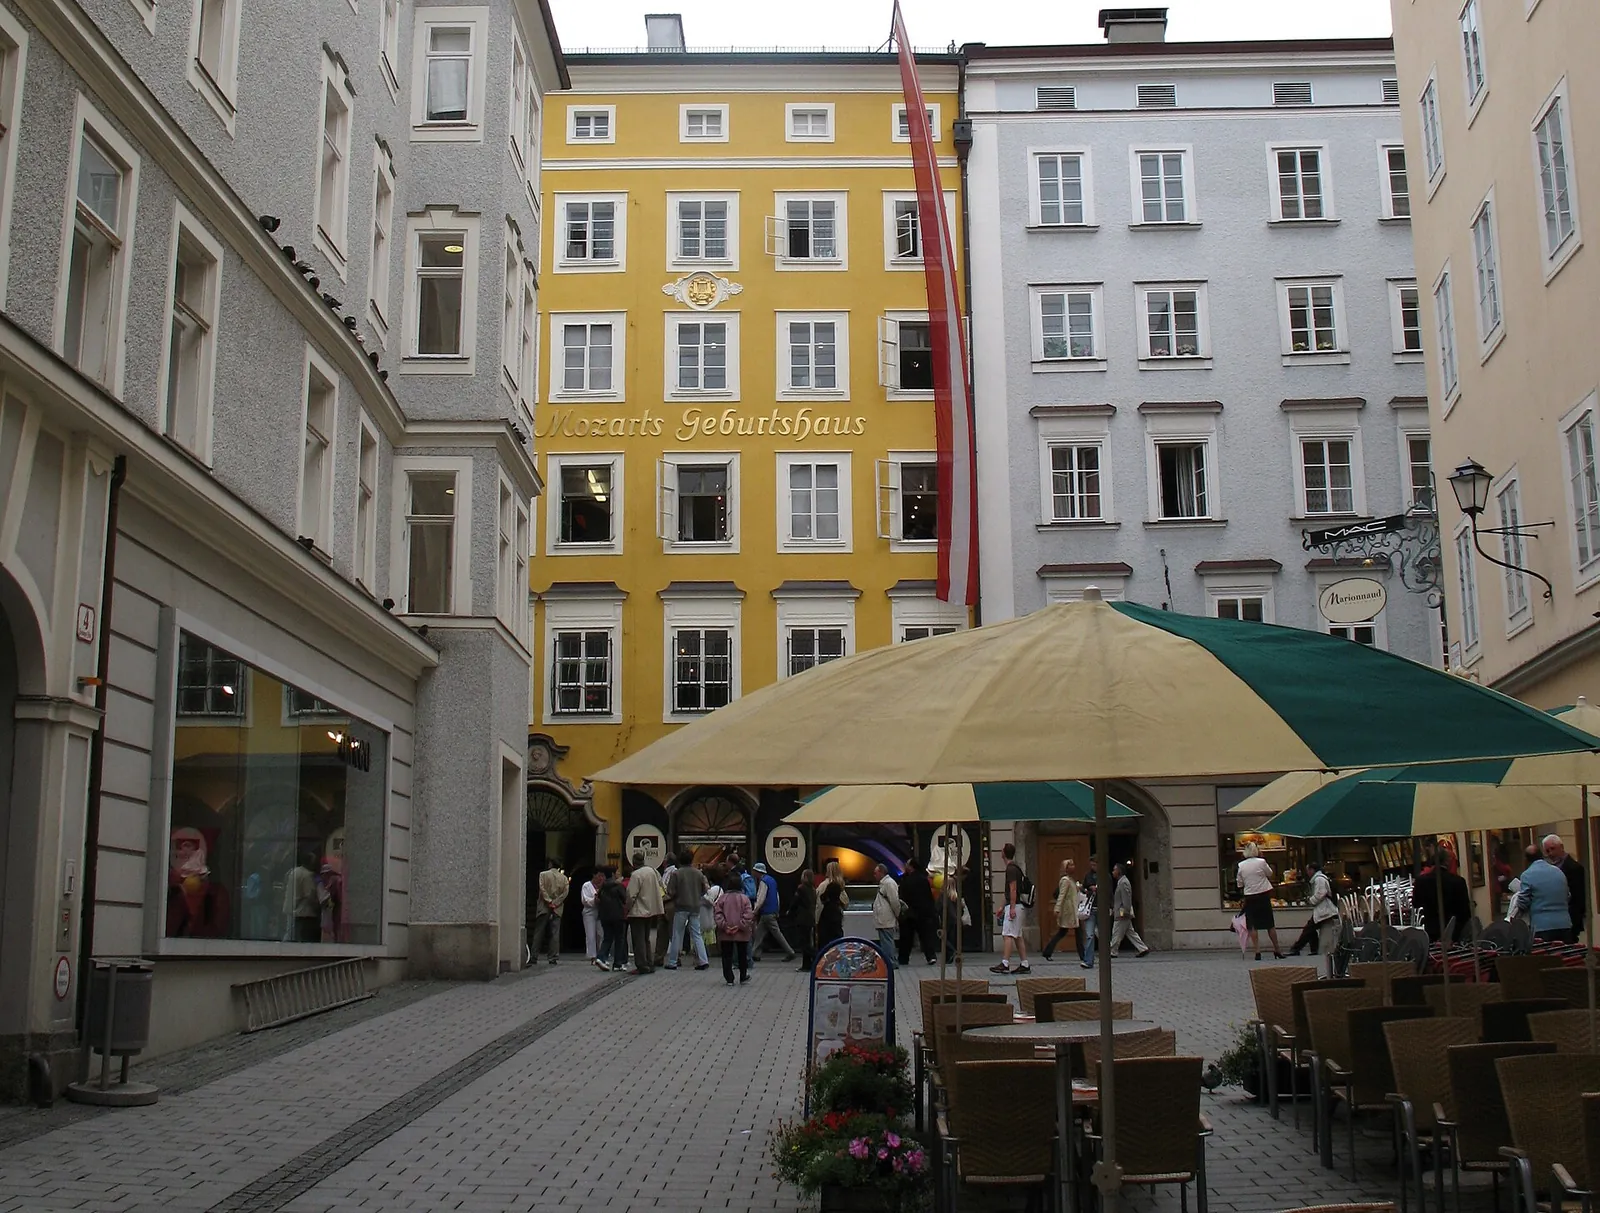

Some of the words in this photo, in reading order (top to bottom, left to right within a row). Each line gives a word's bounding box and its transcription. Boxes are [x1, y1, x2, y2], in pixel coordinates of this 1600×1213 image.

[534, 408, 664, 437] Mozarts
[675, 407, 867, 442] Geburtshaus
[1325, 588, 1381, 609] Marionnaud
